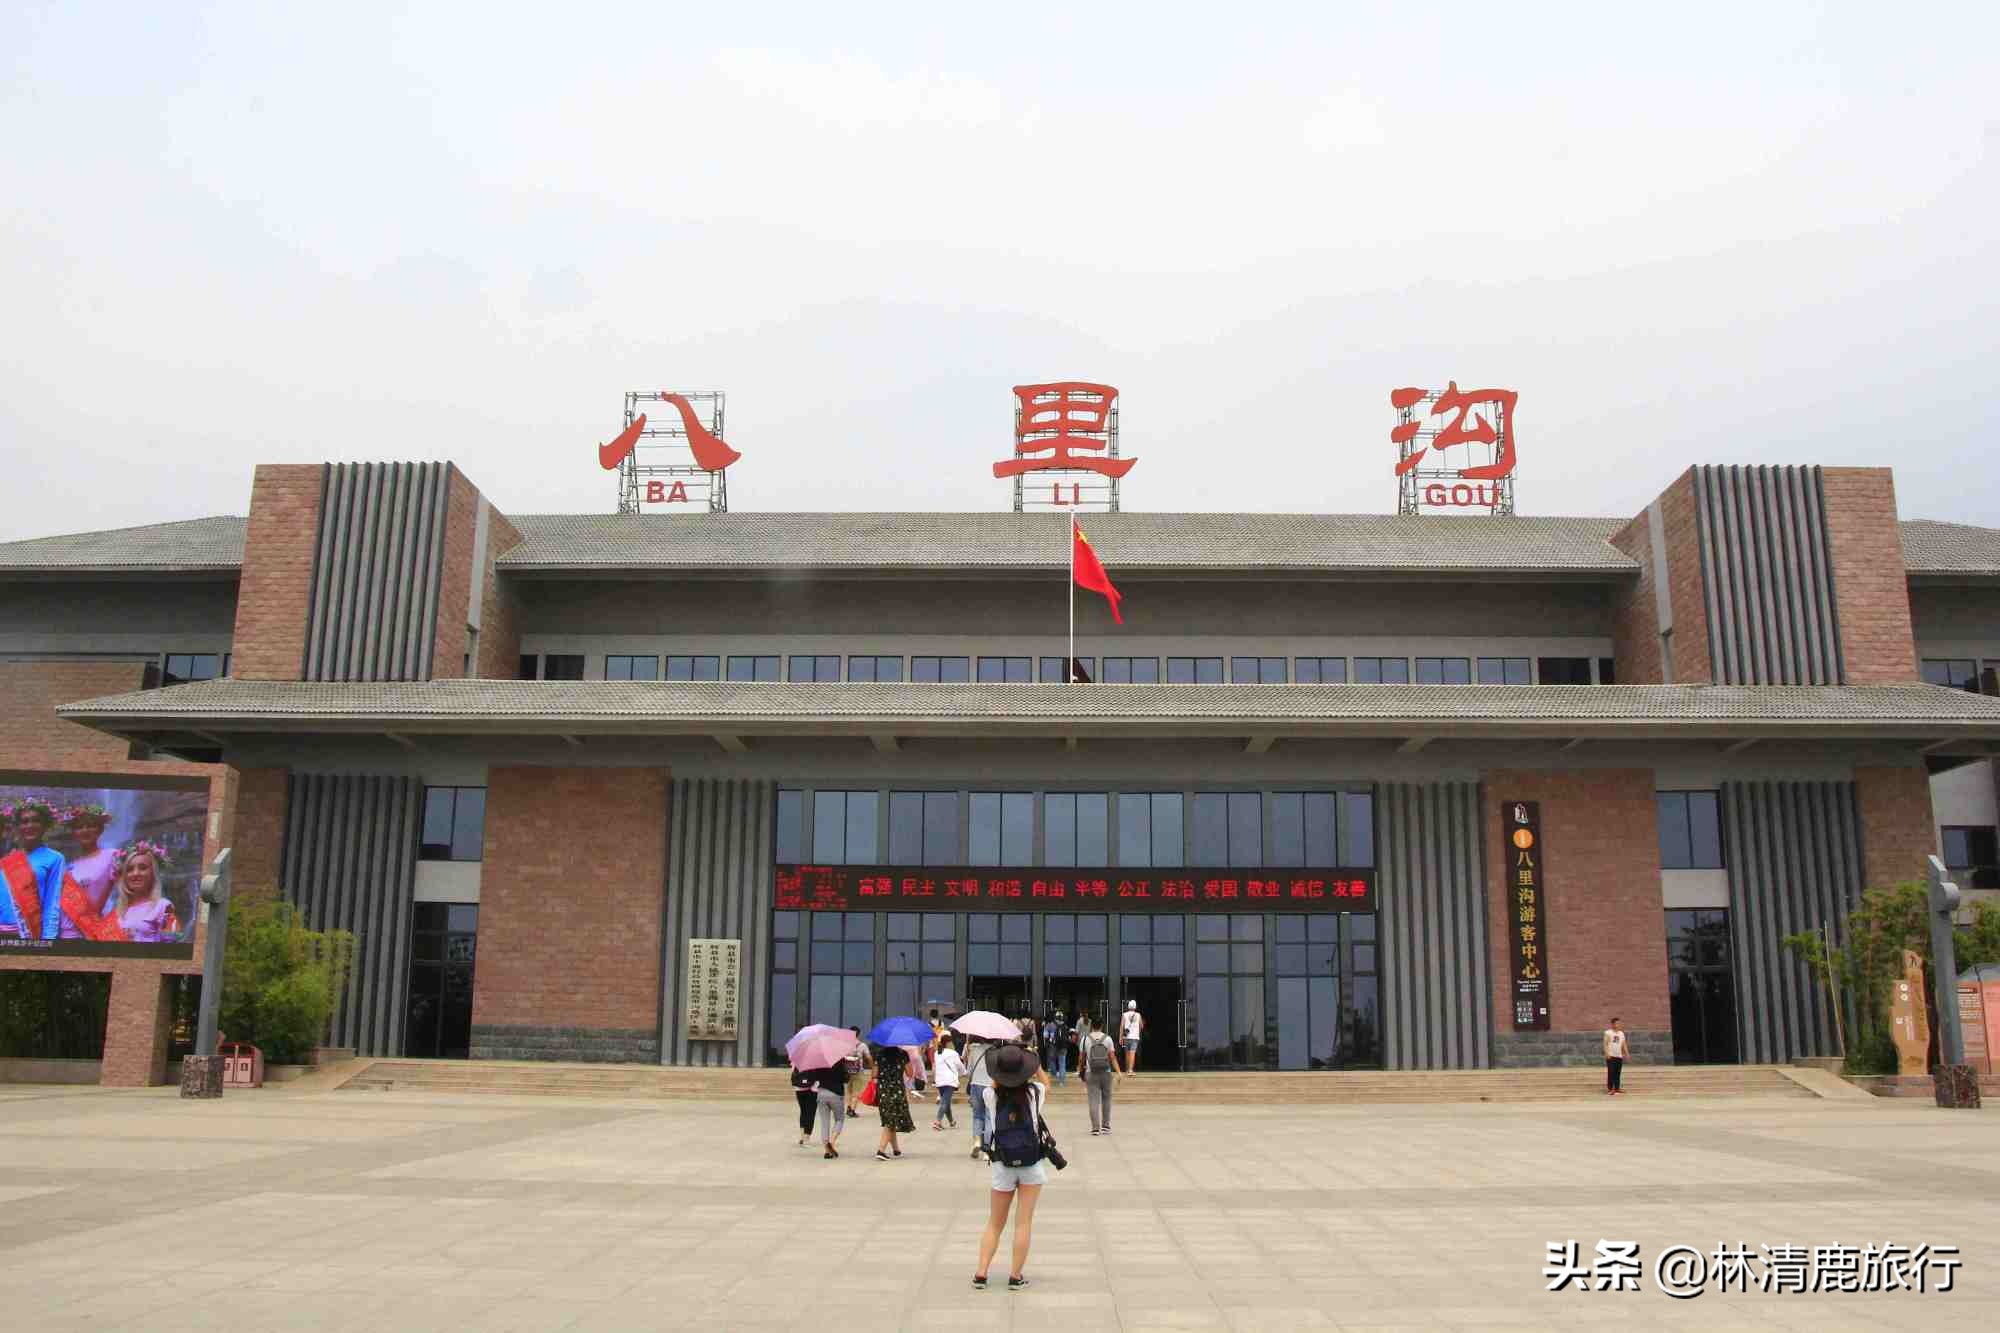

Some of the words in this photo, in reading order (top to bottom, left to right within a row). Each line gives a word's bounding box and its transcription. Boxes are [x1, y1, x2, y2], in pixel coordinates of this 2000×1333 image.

[599, 391, 742, 472] 八
[992, 381, 1138, 479] 里
[1391, 381, 1518, 480] 沟
[646, 480, 689, 503] BA
[1053, 482, 1080, 506] LI
[1425, 483, 1501, 507] GOU
[901, 878, 937, 897] 民主
[943, 879, 980, 897] 文明
[1117, 879, 1151, 897] 公正
[1160, 879, 1195, 898] 法治
[1204, 879, 1239, 898] 爱国
[1247, 879, 1281, 897] 敬业
[1290, 879, 1325, 897] 诚信
[1516, 850, 1541, 979] 八里沟游客中心
